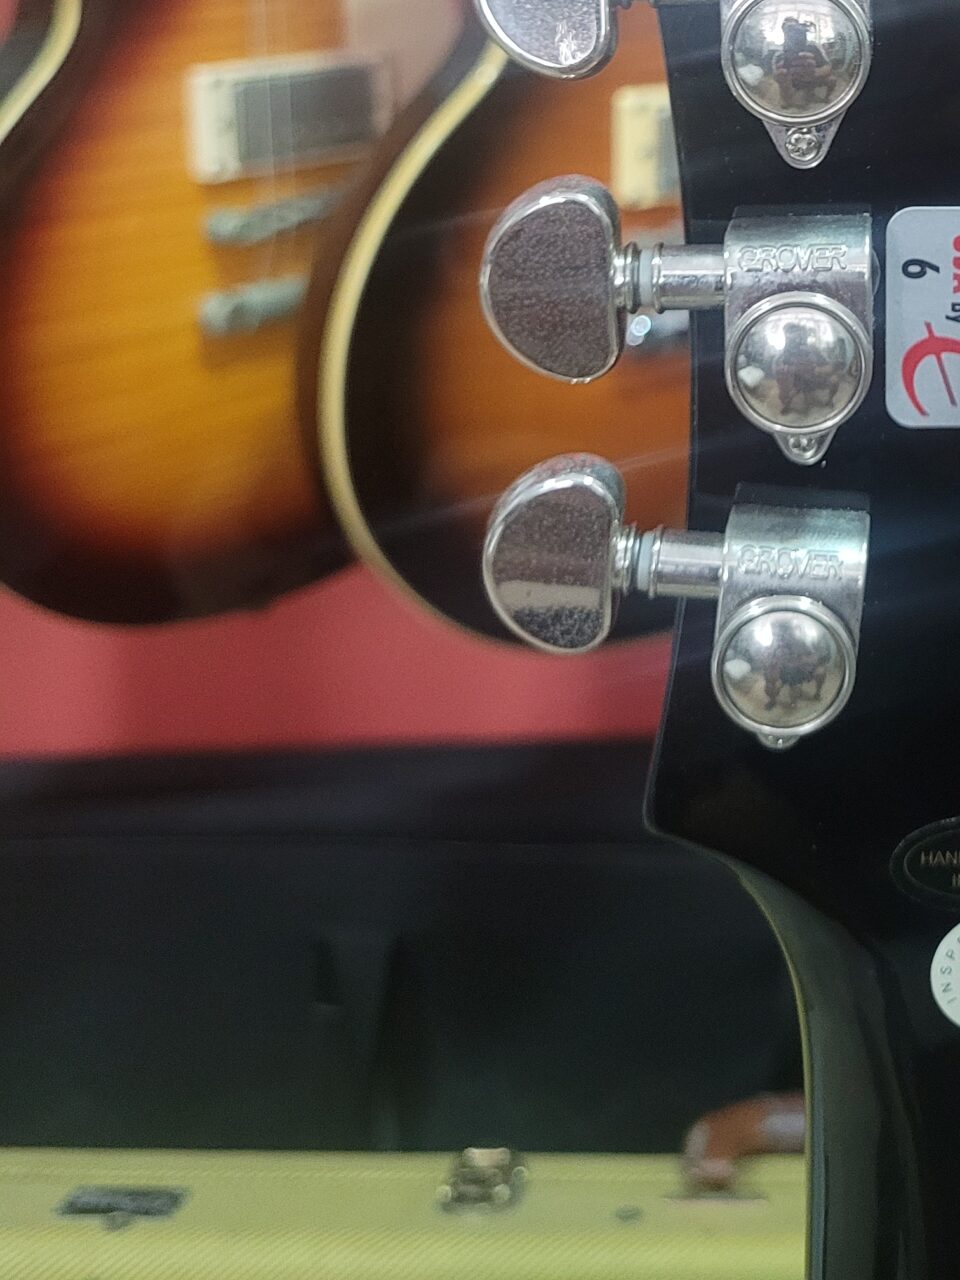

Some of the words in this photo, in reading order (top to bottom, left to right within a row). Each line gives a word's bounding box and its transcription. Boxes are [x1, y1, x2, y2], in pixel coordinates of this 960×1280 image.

[737, 243, 848, 272] GROVER
[901, 258, 941, 280] 6
[737, 543, 845, 581] GROVER
